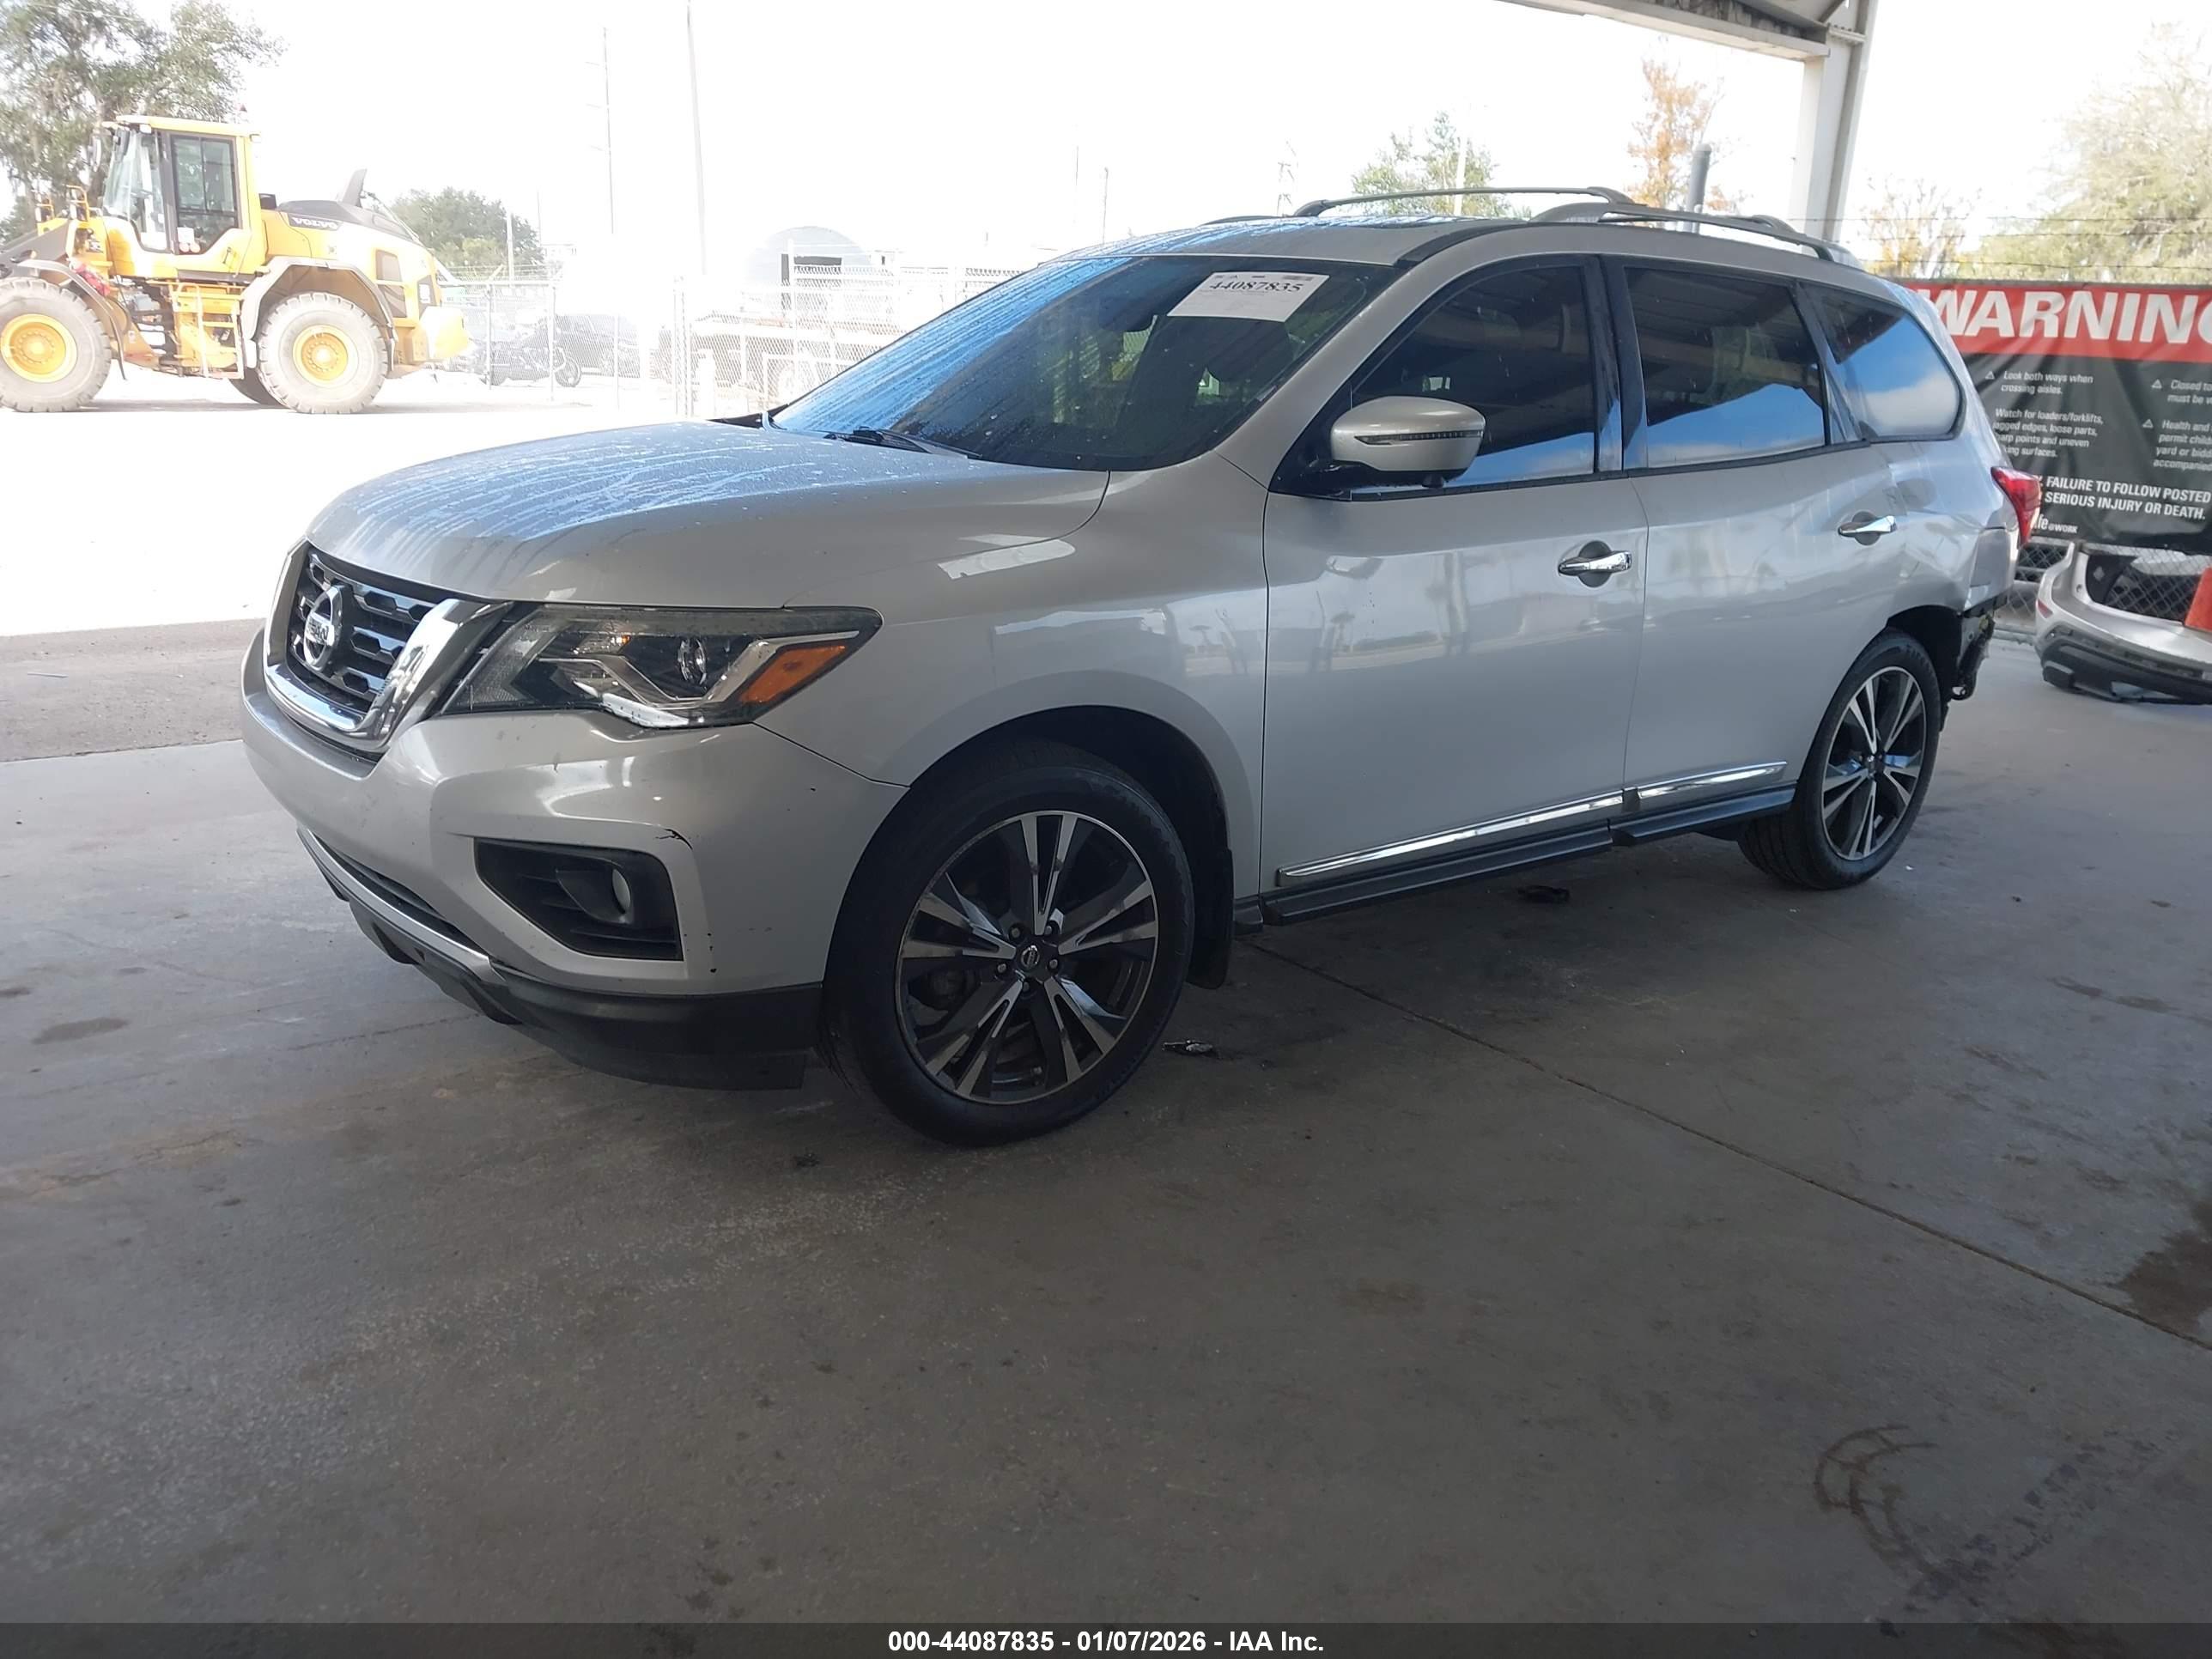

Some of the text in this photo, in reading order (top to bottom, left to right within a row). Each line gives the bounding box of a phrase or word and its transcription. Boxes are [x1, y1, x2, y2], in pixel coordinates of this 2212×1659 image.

[292, 217, 337, 229] VOLVO
[1209, 281, 1304, 292] 44087835
[2003, 371, 2094, 383] Look both ways when
[2001, 385, 2035, 394] crossing
[2192, 395, 2203, 404] be
[1996, 408, 2022, 417] Watch
[2024, 410, 2036, 419] for
[2050, 424, 2072, 434] loose
[2162, 419, 2191, 430] Health
[2015, 434, 2040, 444] points
[2042, 436, 2057, 445] and
[2059, 438, 2089, 447] uneven
[2156, 447, 2177, 456] yard
[2046, 476, 2094, 491] FAILURE
[2096, 480, 2111, 493] TO
[2113, 482, 2161, 498] FOLLOW
[2163, 487, 2211, 503] POSTED
[2045, 491, 2205, 520] SERIOUS INJURY OR DEATH.
